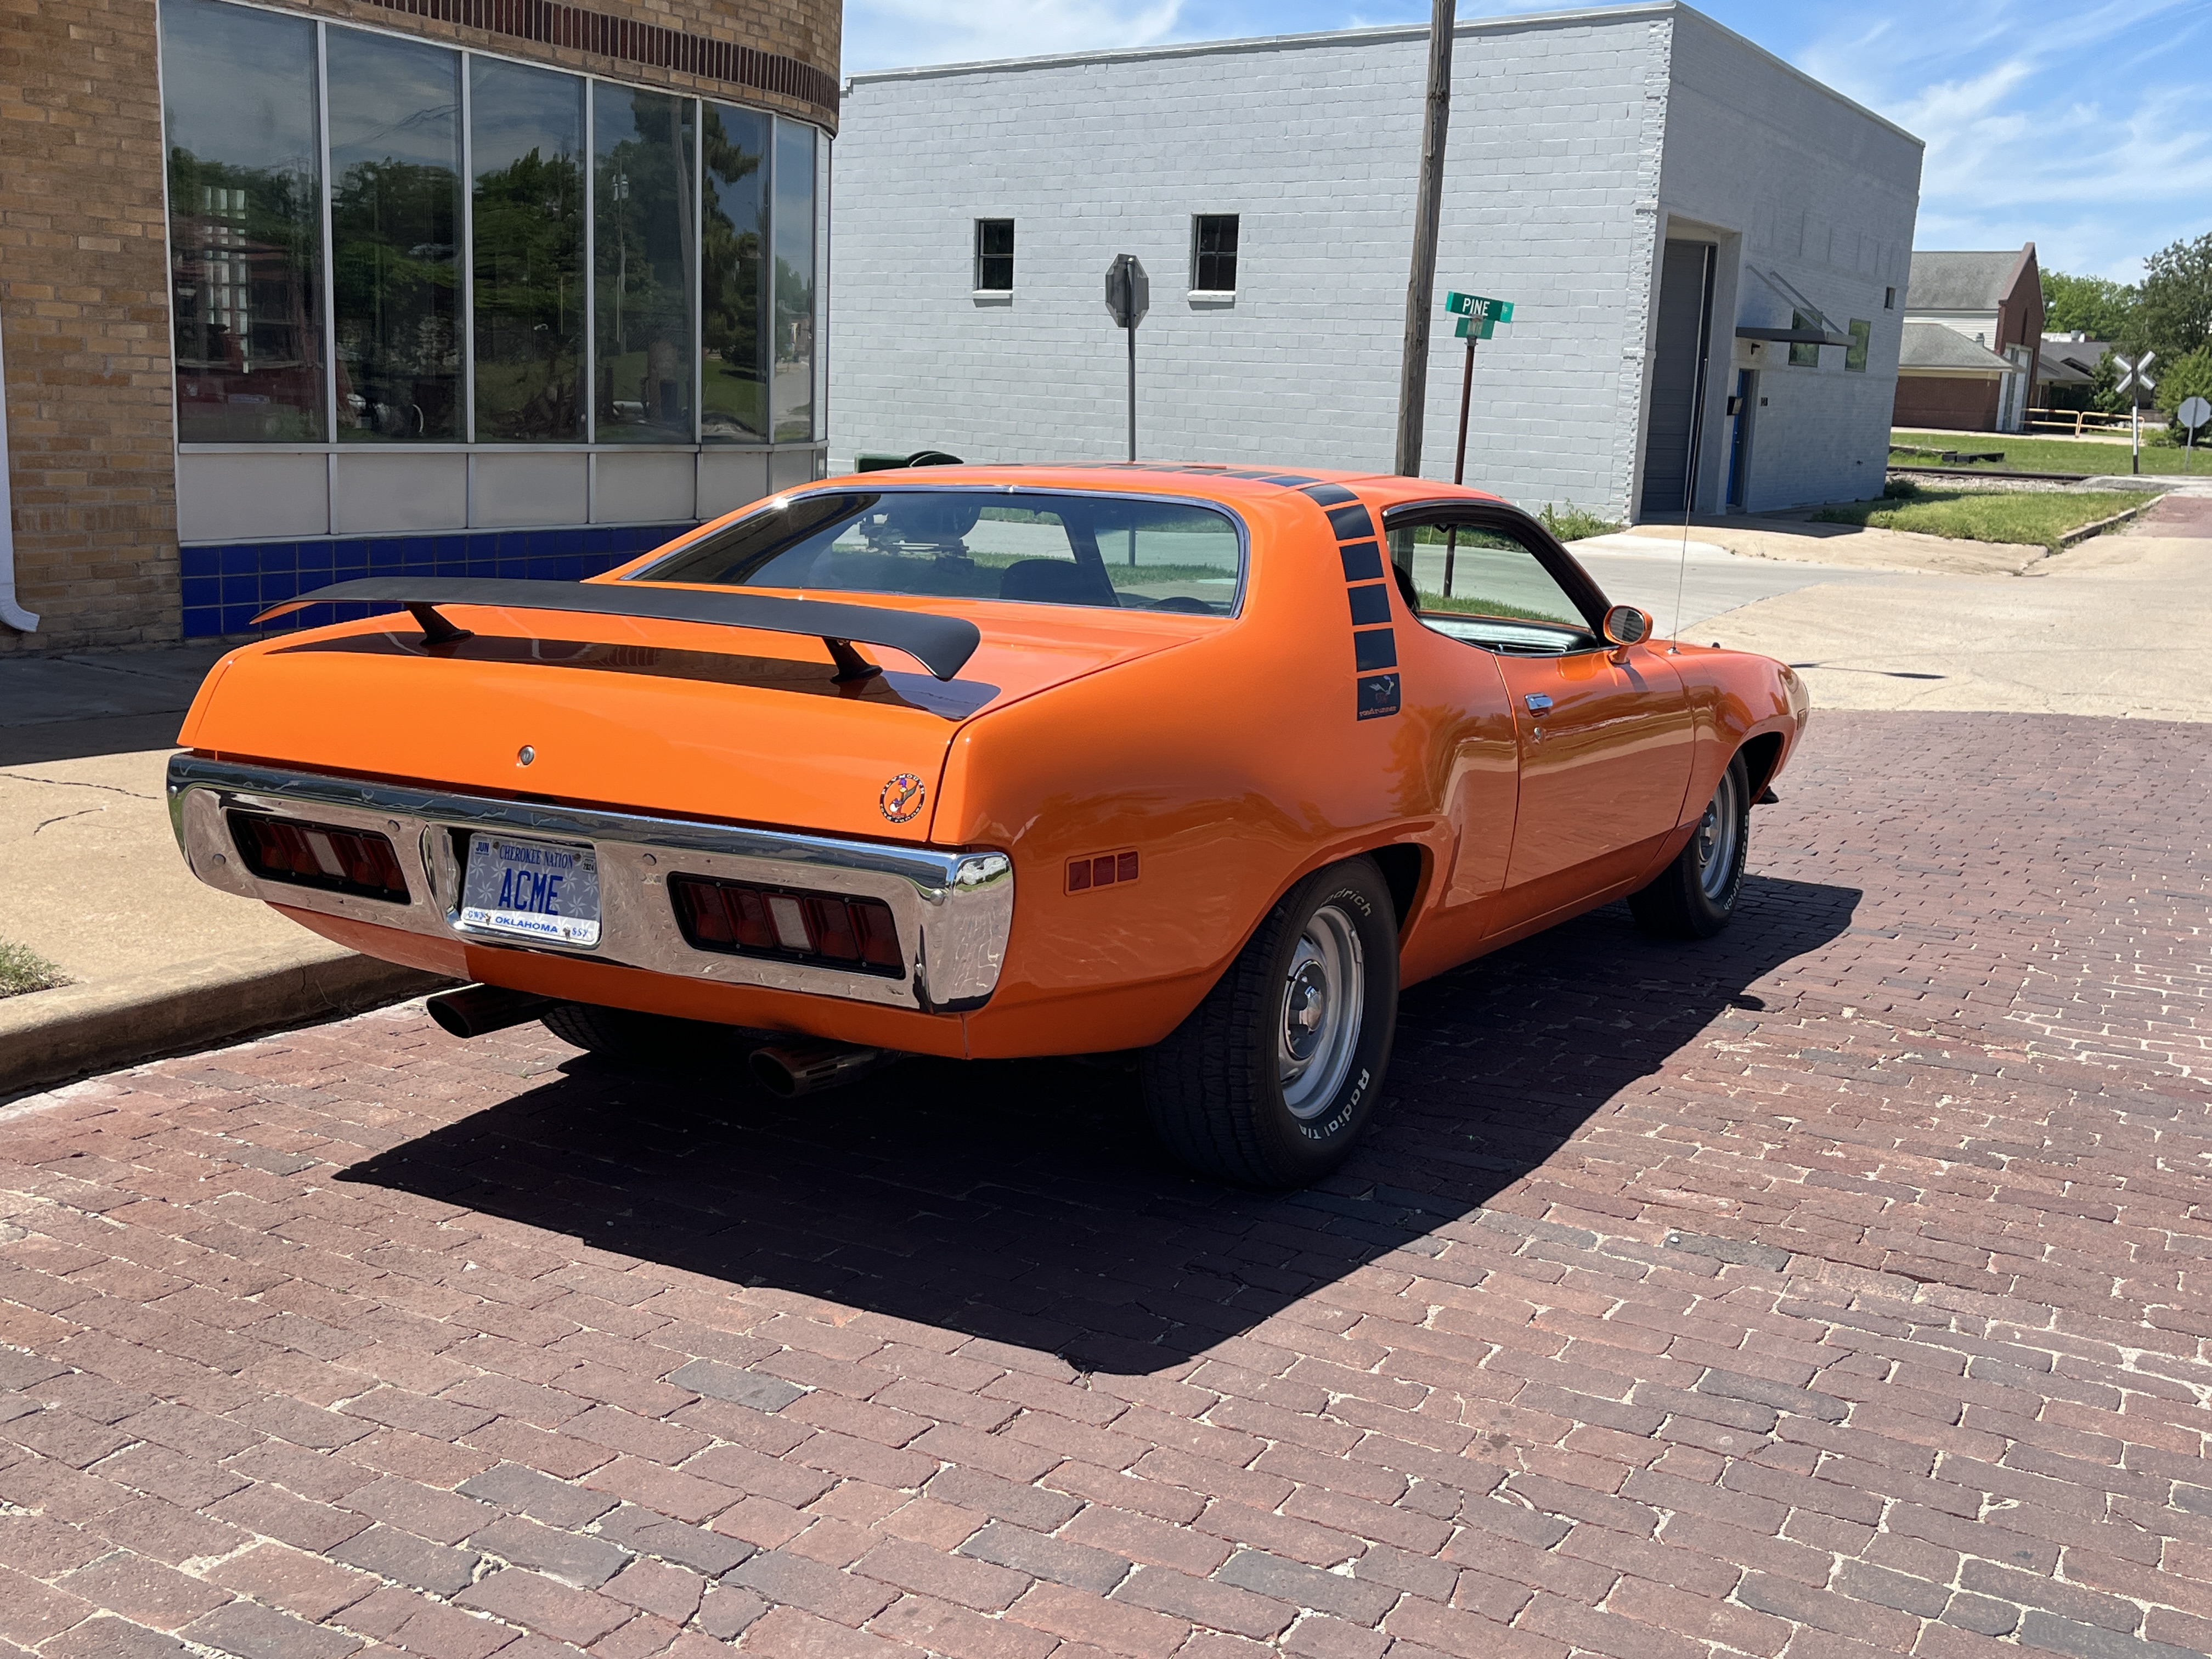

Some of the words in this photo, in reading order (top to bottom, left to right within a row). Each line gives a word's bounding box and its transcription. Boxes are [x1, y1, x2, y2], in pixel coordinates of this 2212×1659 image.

[1462, 297, 1491, 316] PINE
[476, 842, 489, 853] JUN
[500, 844, 541, 865] CHEROKEE
[544, 851, 573, 870] NATION
[498, 868, 564, 916] ACME
[1319, 888, 1372, 917] odrich
[495, 916, 558, 933] OKLAHOMA
[1323, 1068, 1370, 1137] Radial
